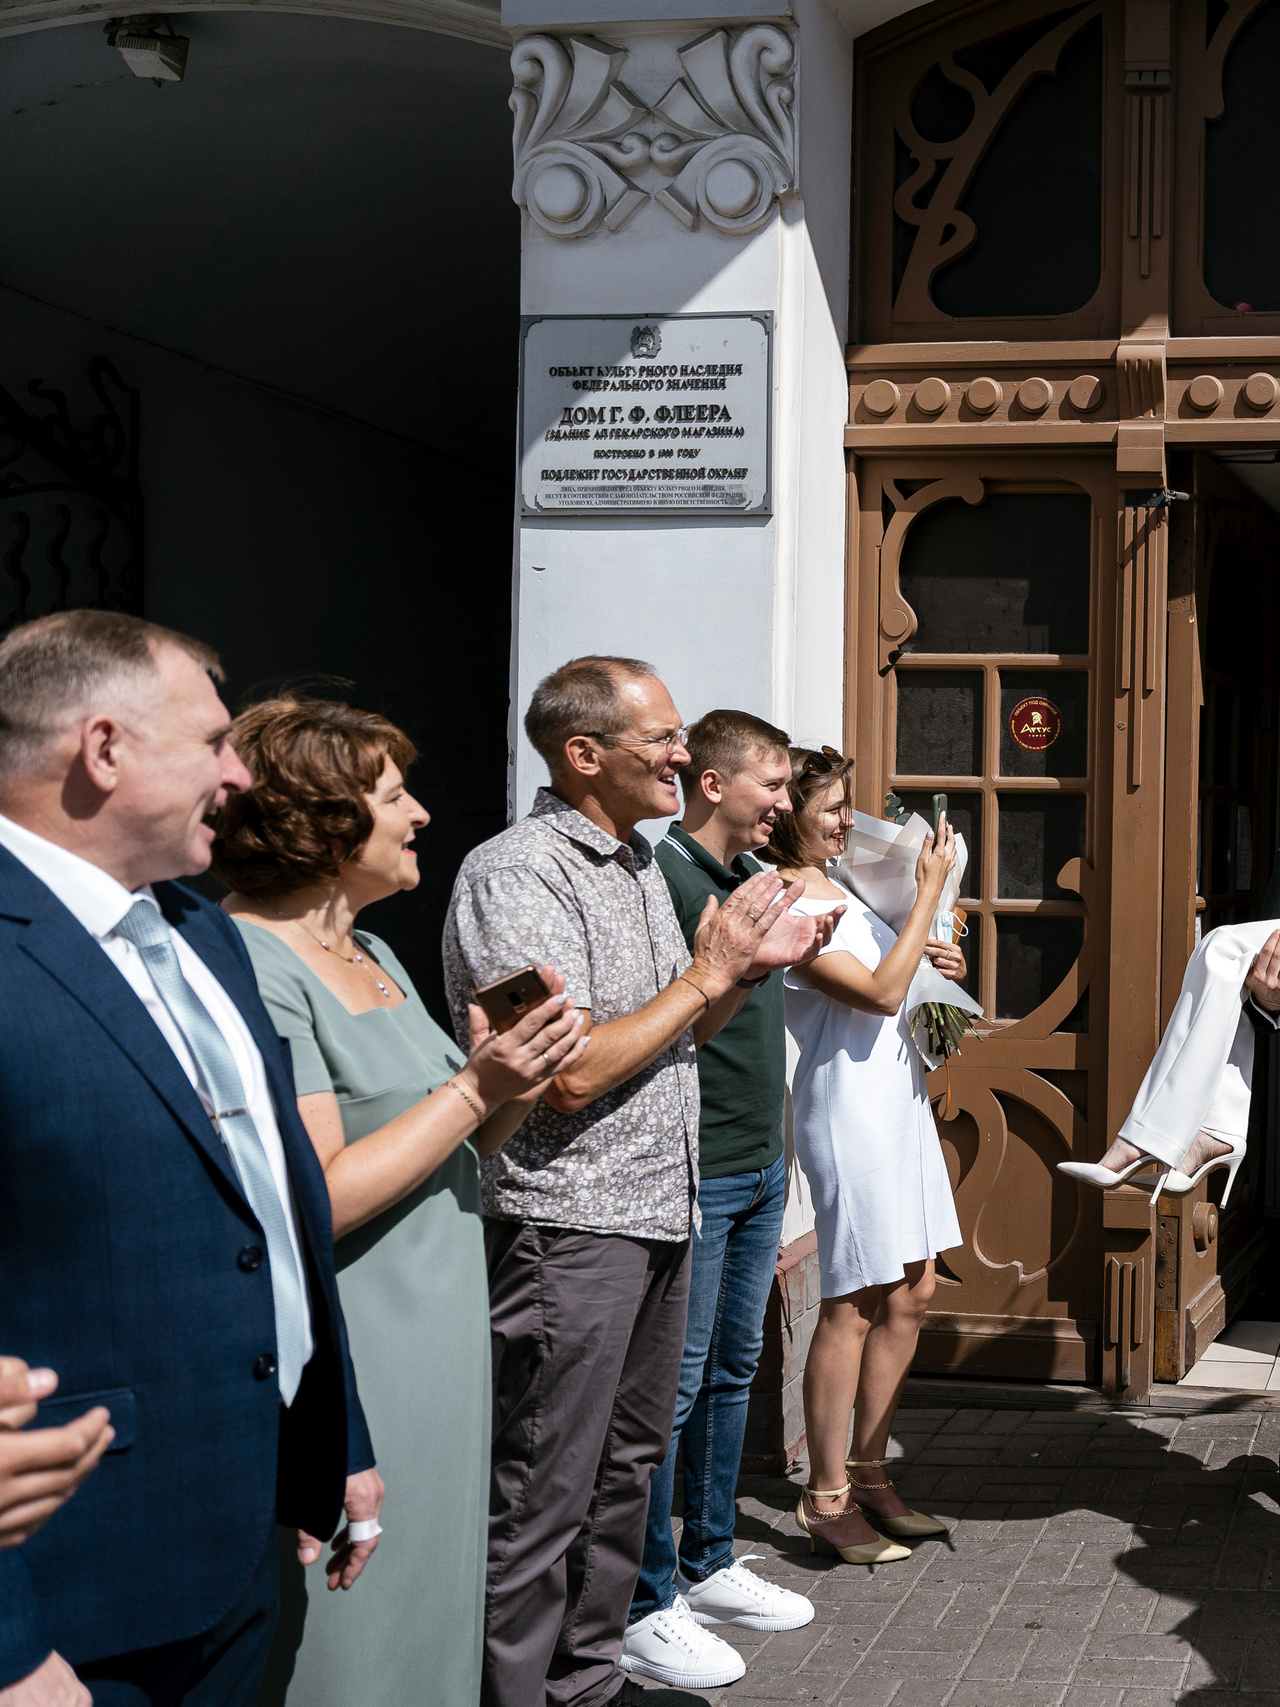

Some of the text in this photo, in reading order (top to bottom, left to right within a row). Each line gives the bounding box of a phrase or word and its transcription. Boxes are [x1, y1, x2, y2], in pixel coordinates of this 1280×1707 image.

[549, 364, 743, 377] ОБЪЕКТ КУЛЬТУРНОГО НАСЛЕДИЯ
[572, 378, 727, 392] ФЕДЕРАЛЬНОГО ЗНАЧЕНИЯ
[559, 404, 732, 427] ДОМ Г. Ф. ФЛЕЕРА
[545, 426, 745, 441] (ЗДАНИЕ АПТЕКАРСКОГО МАГАЗИНА)
[593, 449, 646, 459] ПОСТРОЕНО
[648, 449, 655, 459] В
[677, 448, 701, 459] ГОДУ
[541, 466, 748, 482] ПОДЛЕЖИТ ГОСУДАРСТВЕННОЙ ОХРАНЕ
